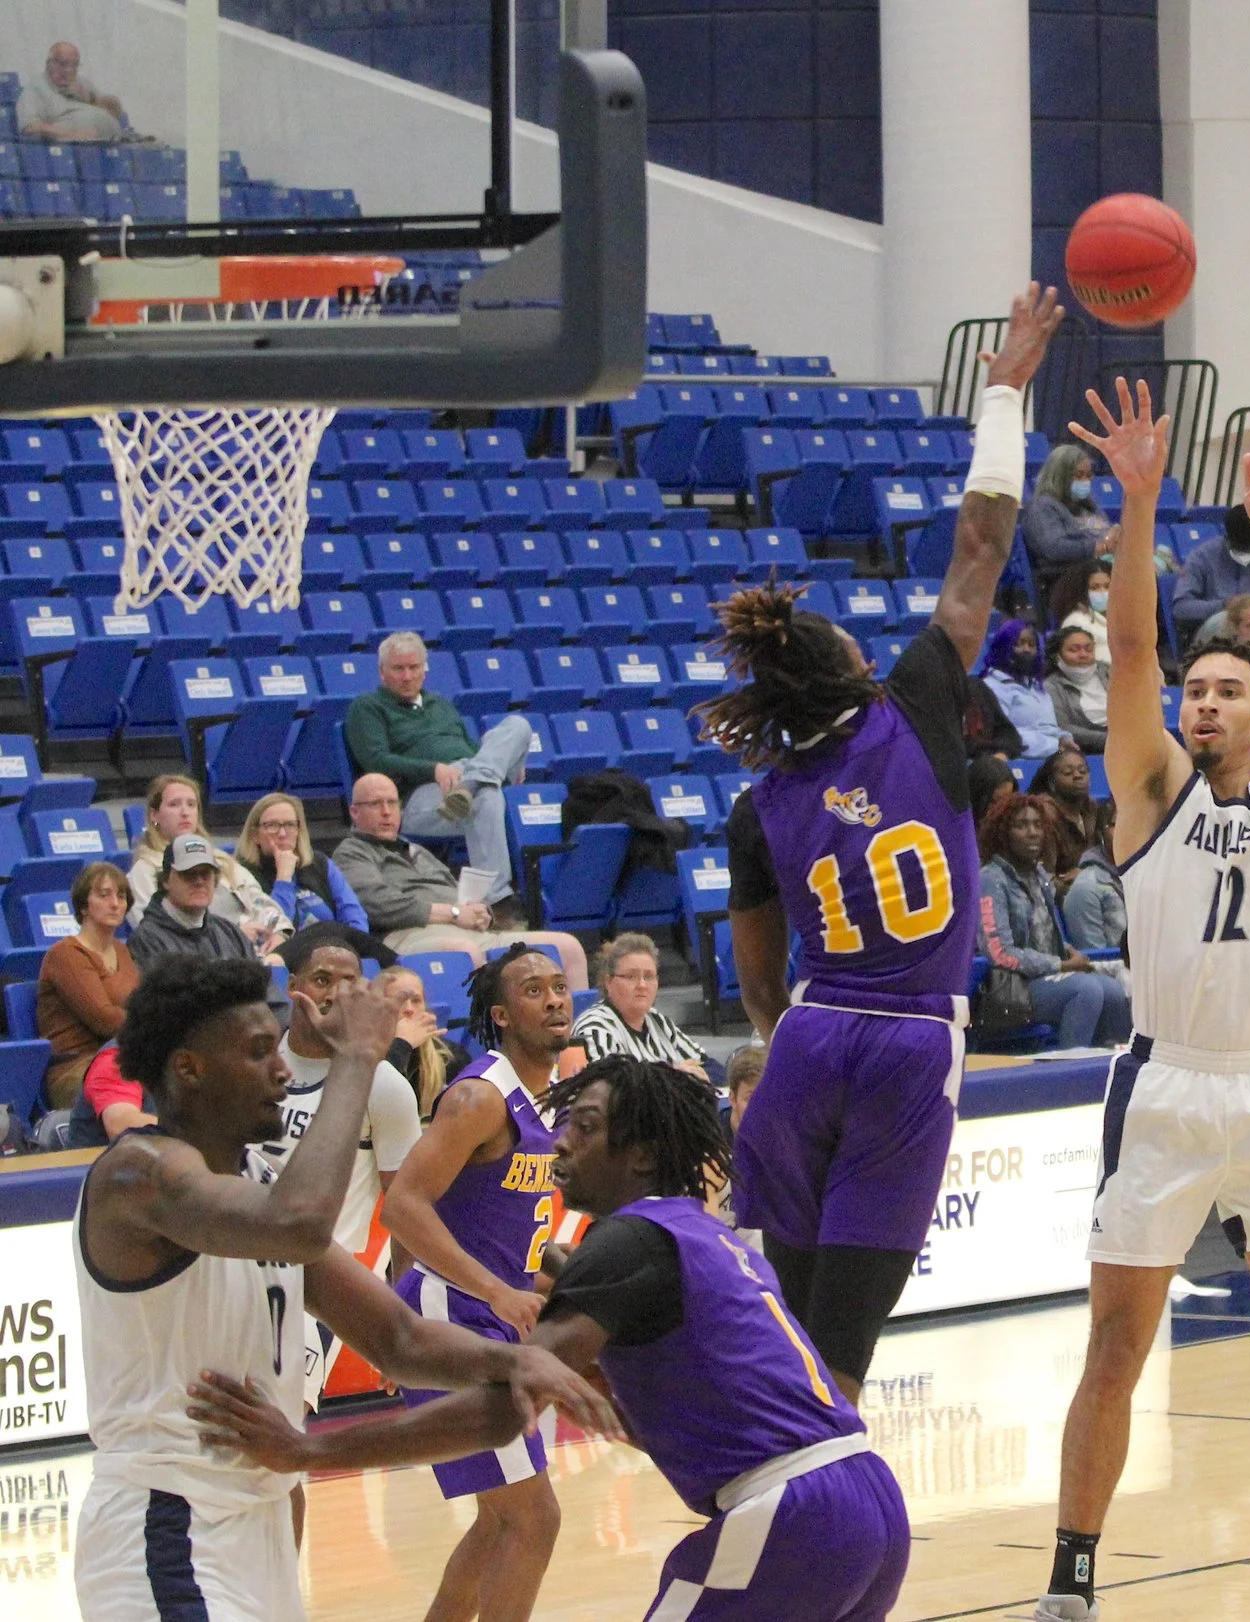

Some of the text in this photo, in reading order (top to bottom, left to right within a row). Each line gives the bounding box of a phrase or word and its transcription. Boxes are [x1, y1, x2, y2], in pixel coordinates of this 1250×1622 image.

[806, 819, 957, 954] 10
[1201, 866, 1249, 943] 12
[971, 1146, 1024, 1186] FOR
[523, 1196, 553, 1273] 2
[910, 1241, 933, 1277] E
[0, 1334, 67, 1397] nel
